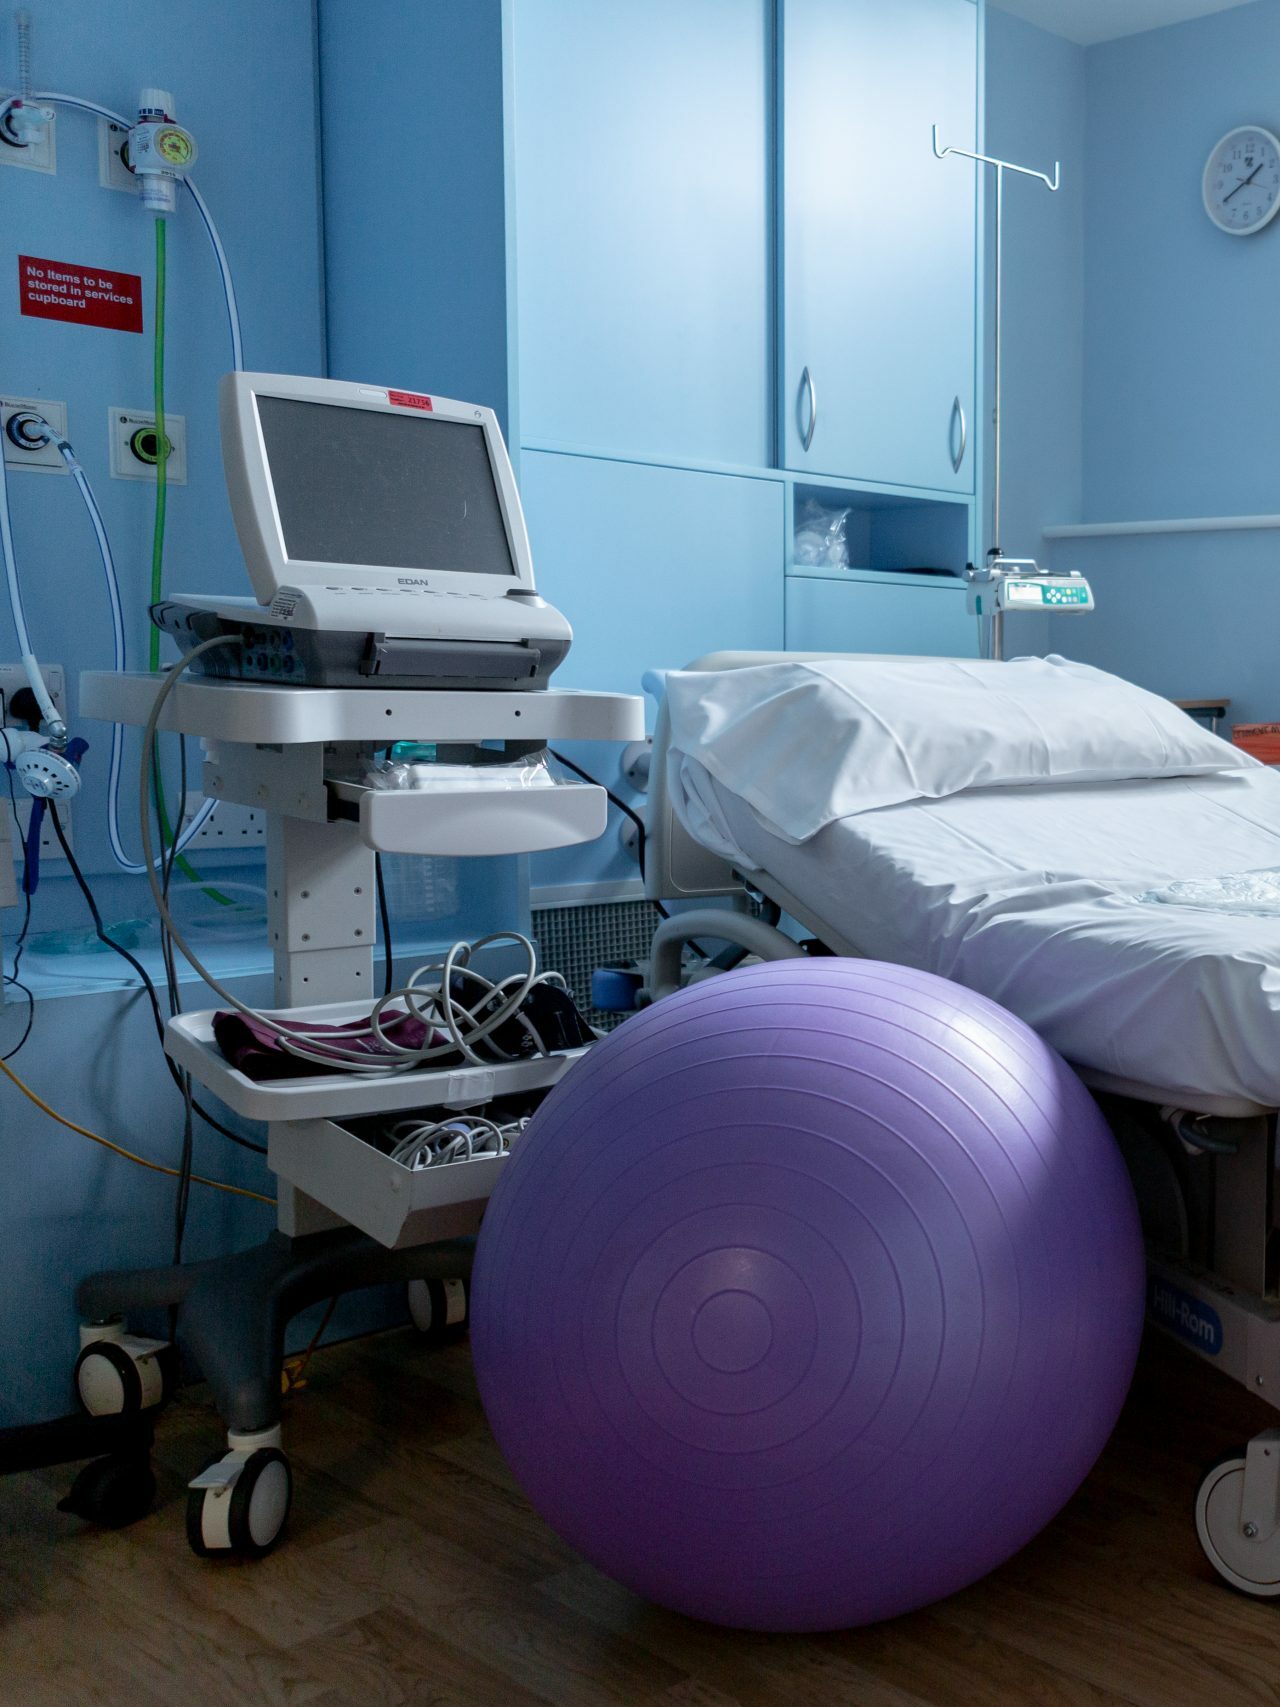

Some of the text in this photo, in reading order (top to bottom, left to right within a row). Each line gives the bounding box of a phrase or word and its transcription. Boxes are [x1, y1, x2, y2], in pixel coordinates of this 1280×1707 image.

[27, 265, 113, 290] No Items to be
[28, 279, 133, 305] stored in services
[28, 291, 86, 309] cupboard
[397, 577, 429, 586] EDAN
[1153, 1283, 1214, 1344] Hill-Rom
